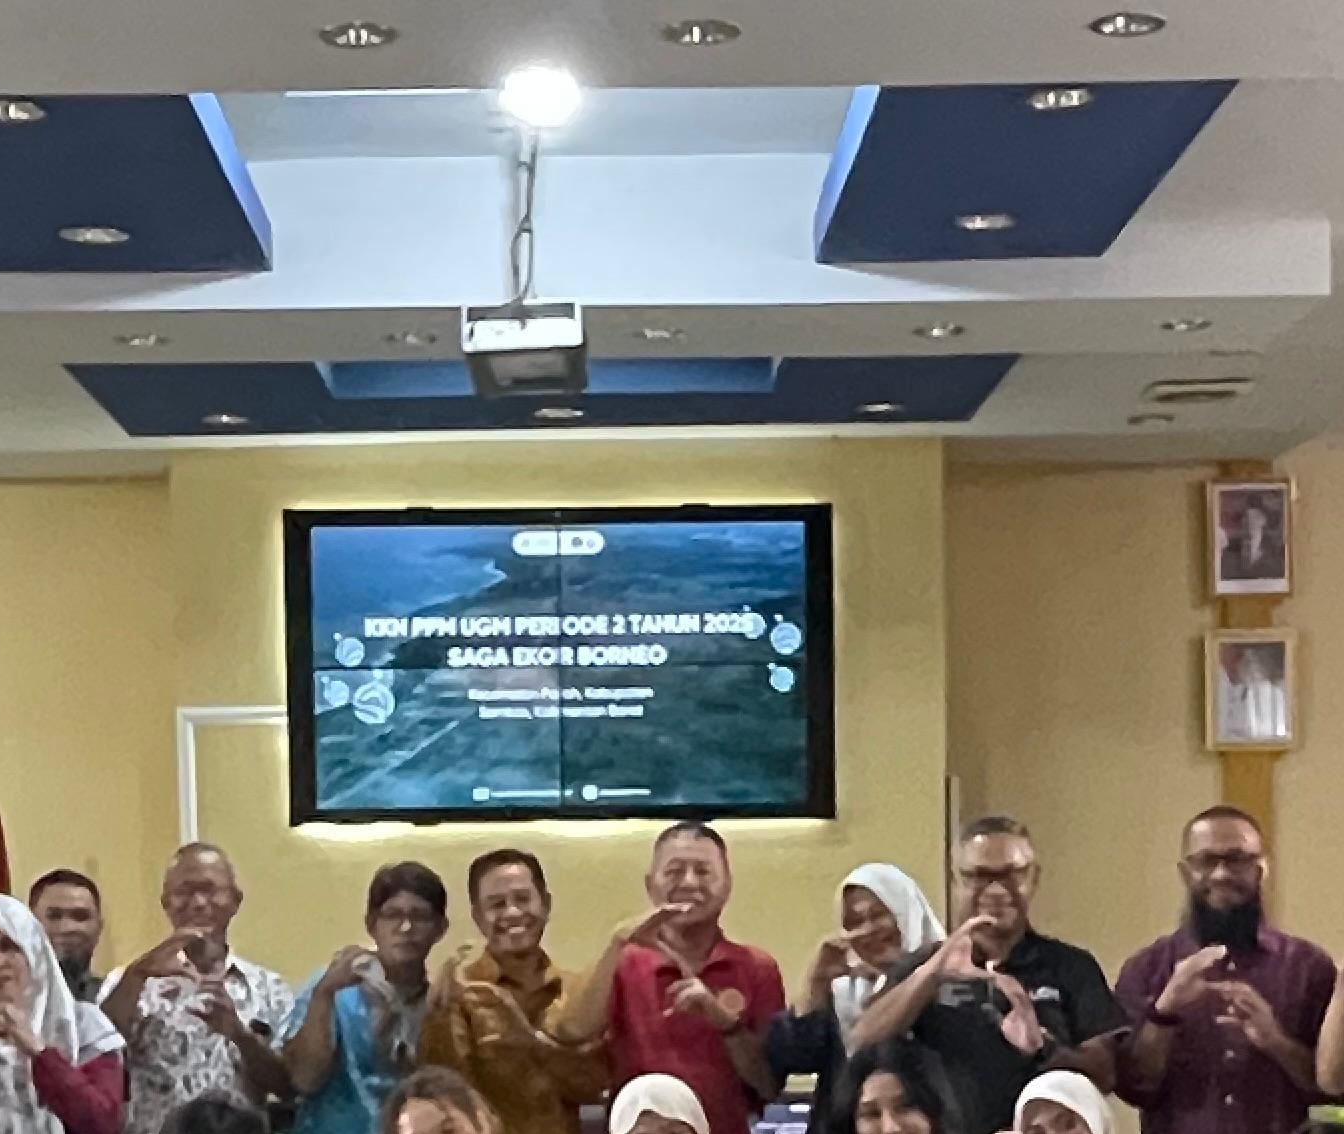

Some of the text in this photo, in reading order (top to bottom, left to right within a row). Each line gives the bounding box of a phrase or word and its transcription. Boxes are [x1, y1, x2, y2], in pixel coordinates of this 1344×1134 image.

[459, 615, 511, 637] UGM
[611, 614, 626, 635] 2
[628, 613, 700, 635] TAHUN
[447, 646, 510, 667] SAGA
[577, 643, 668, 667] BORNEO
